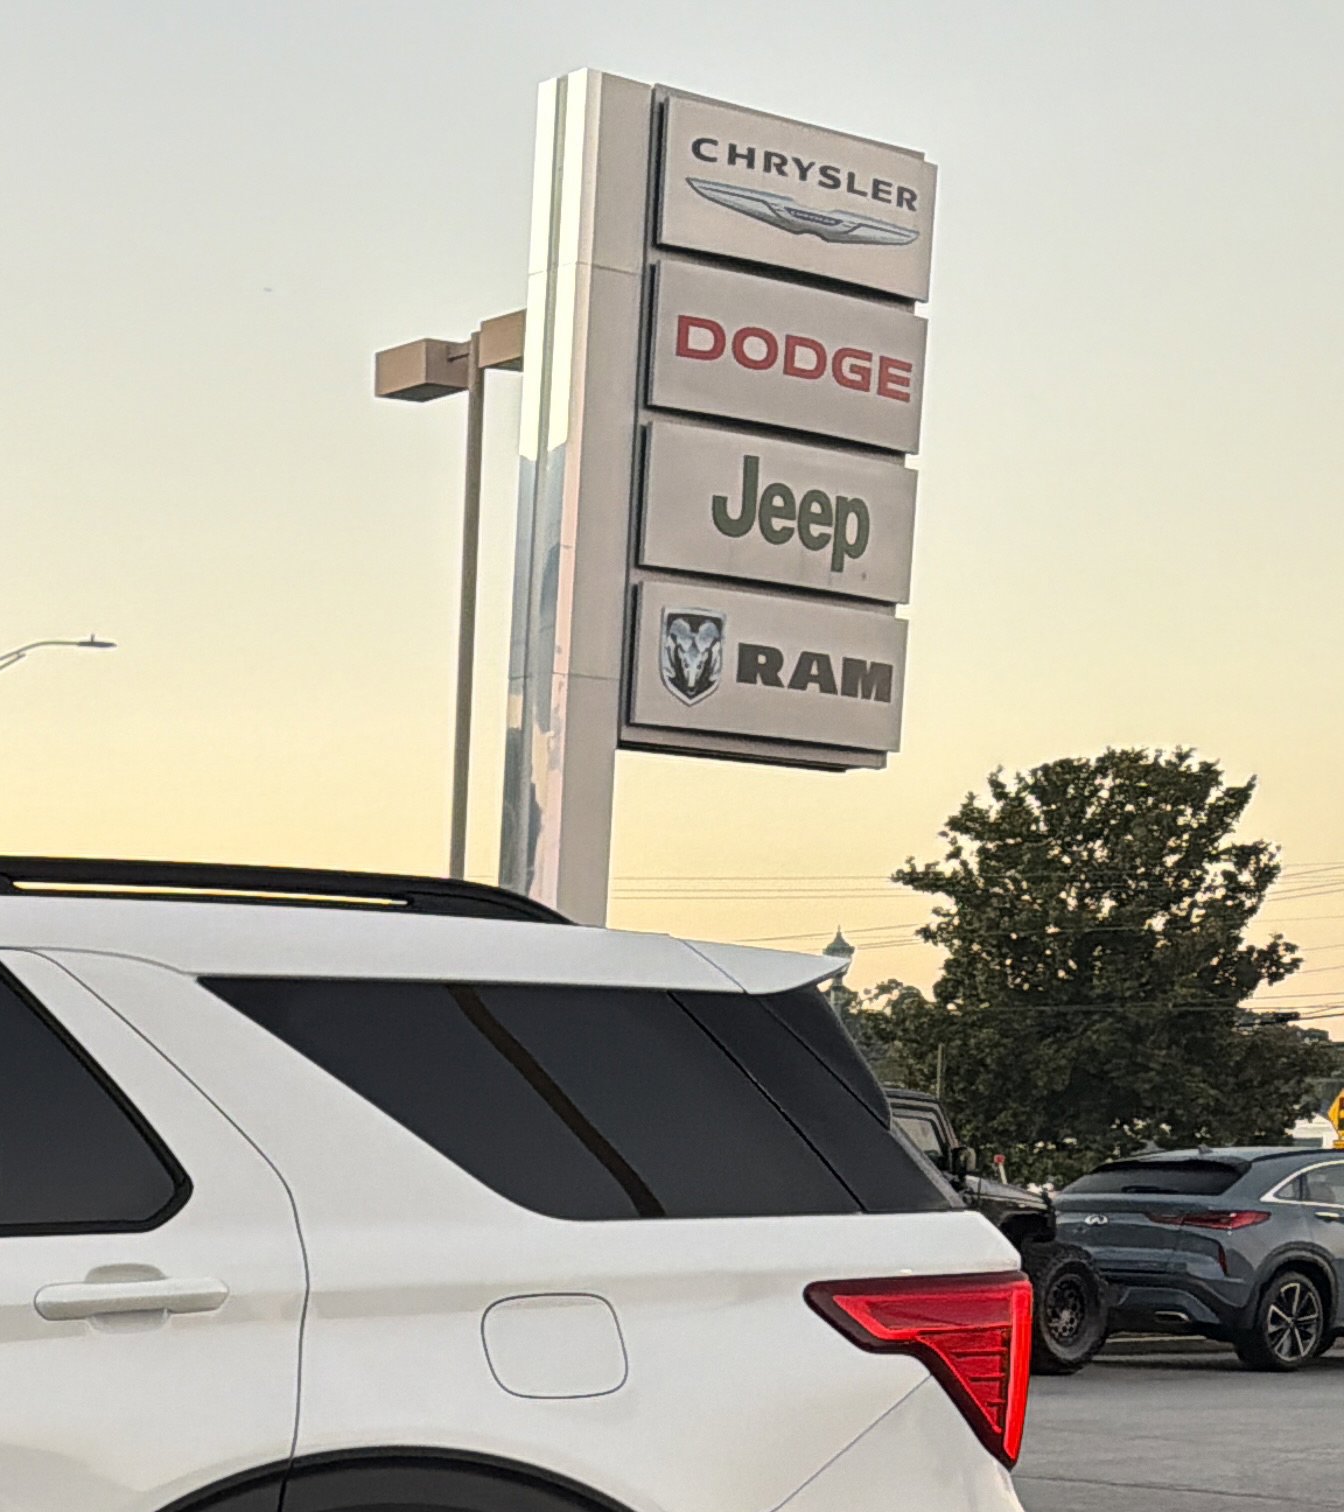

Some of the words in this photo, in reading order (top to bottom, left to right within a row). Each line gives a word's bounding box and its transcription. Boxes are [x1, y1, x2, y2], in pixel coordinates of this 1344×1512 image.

[691, 137, 918, 213] CHRYSLER
[676, 314, 912, 402] DODGE
[712, 455, 870, 572] Jeep
[736, 642, 894, 702] RAM
